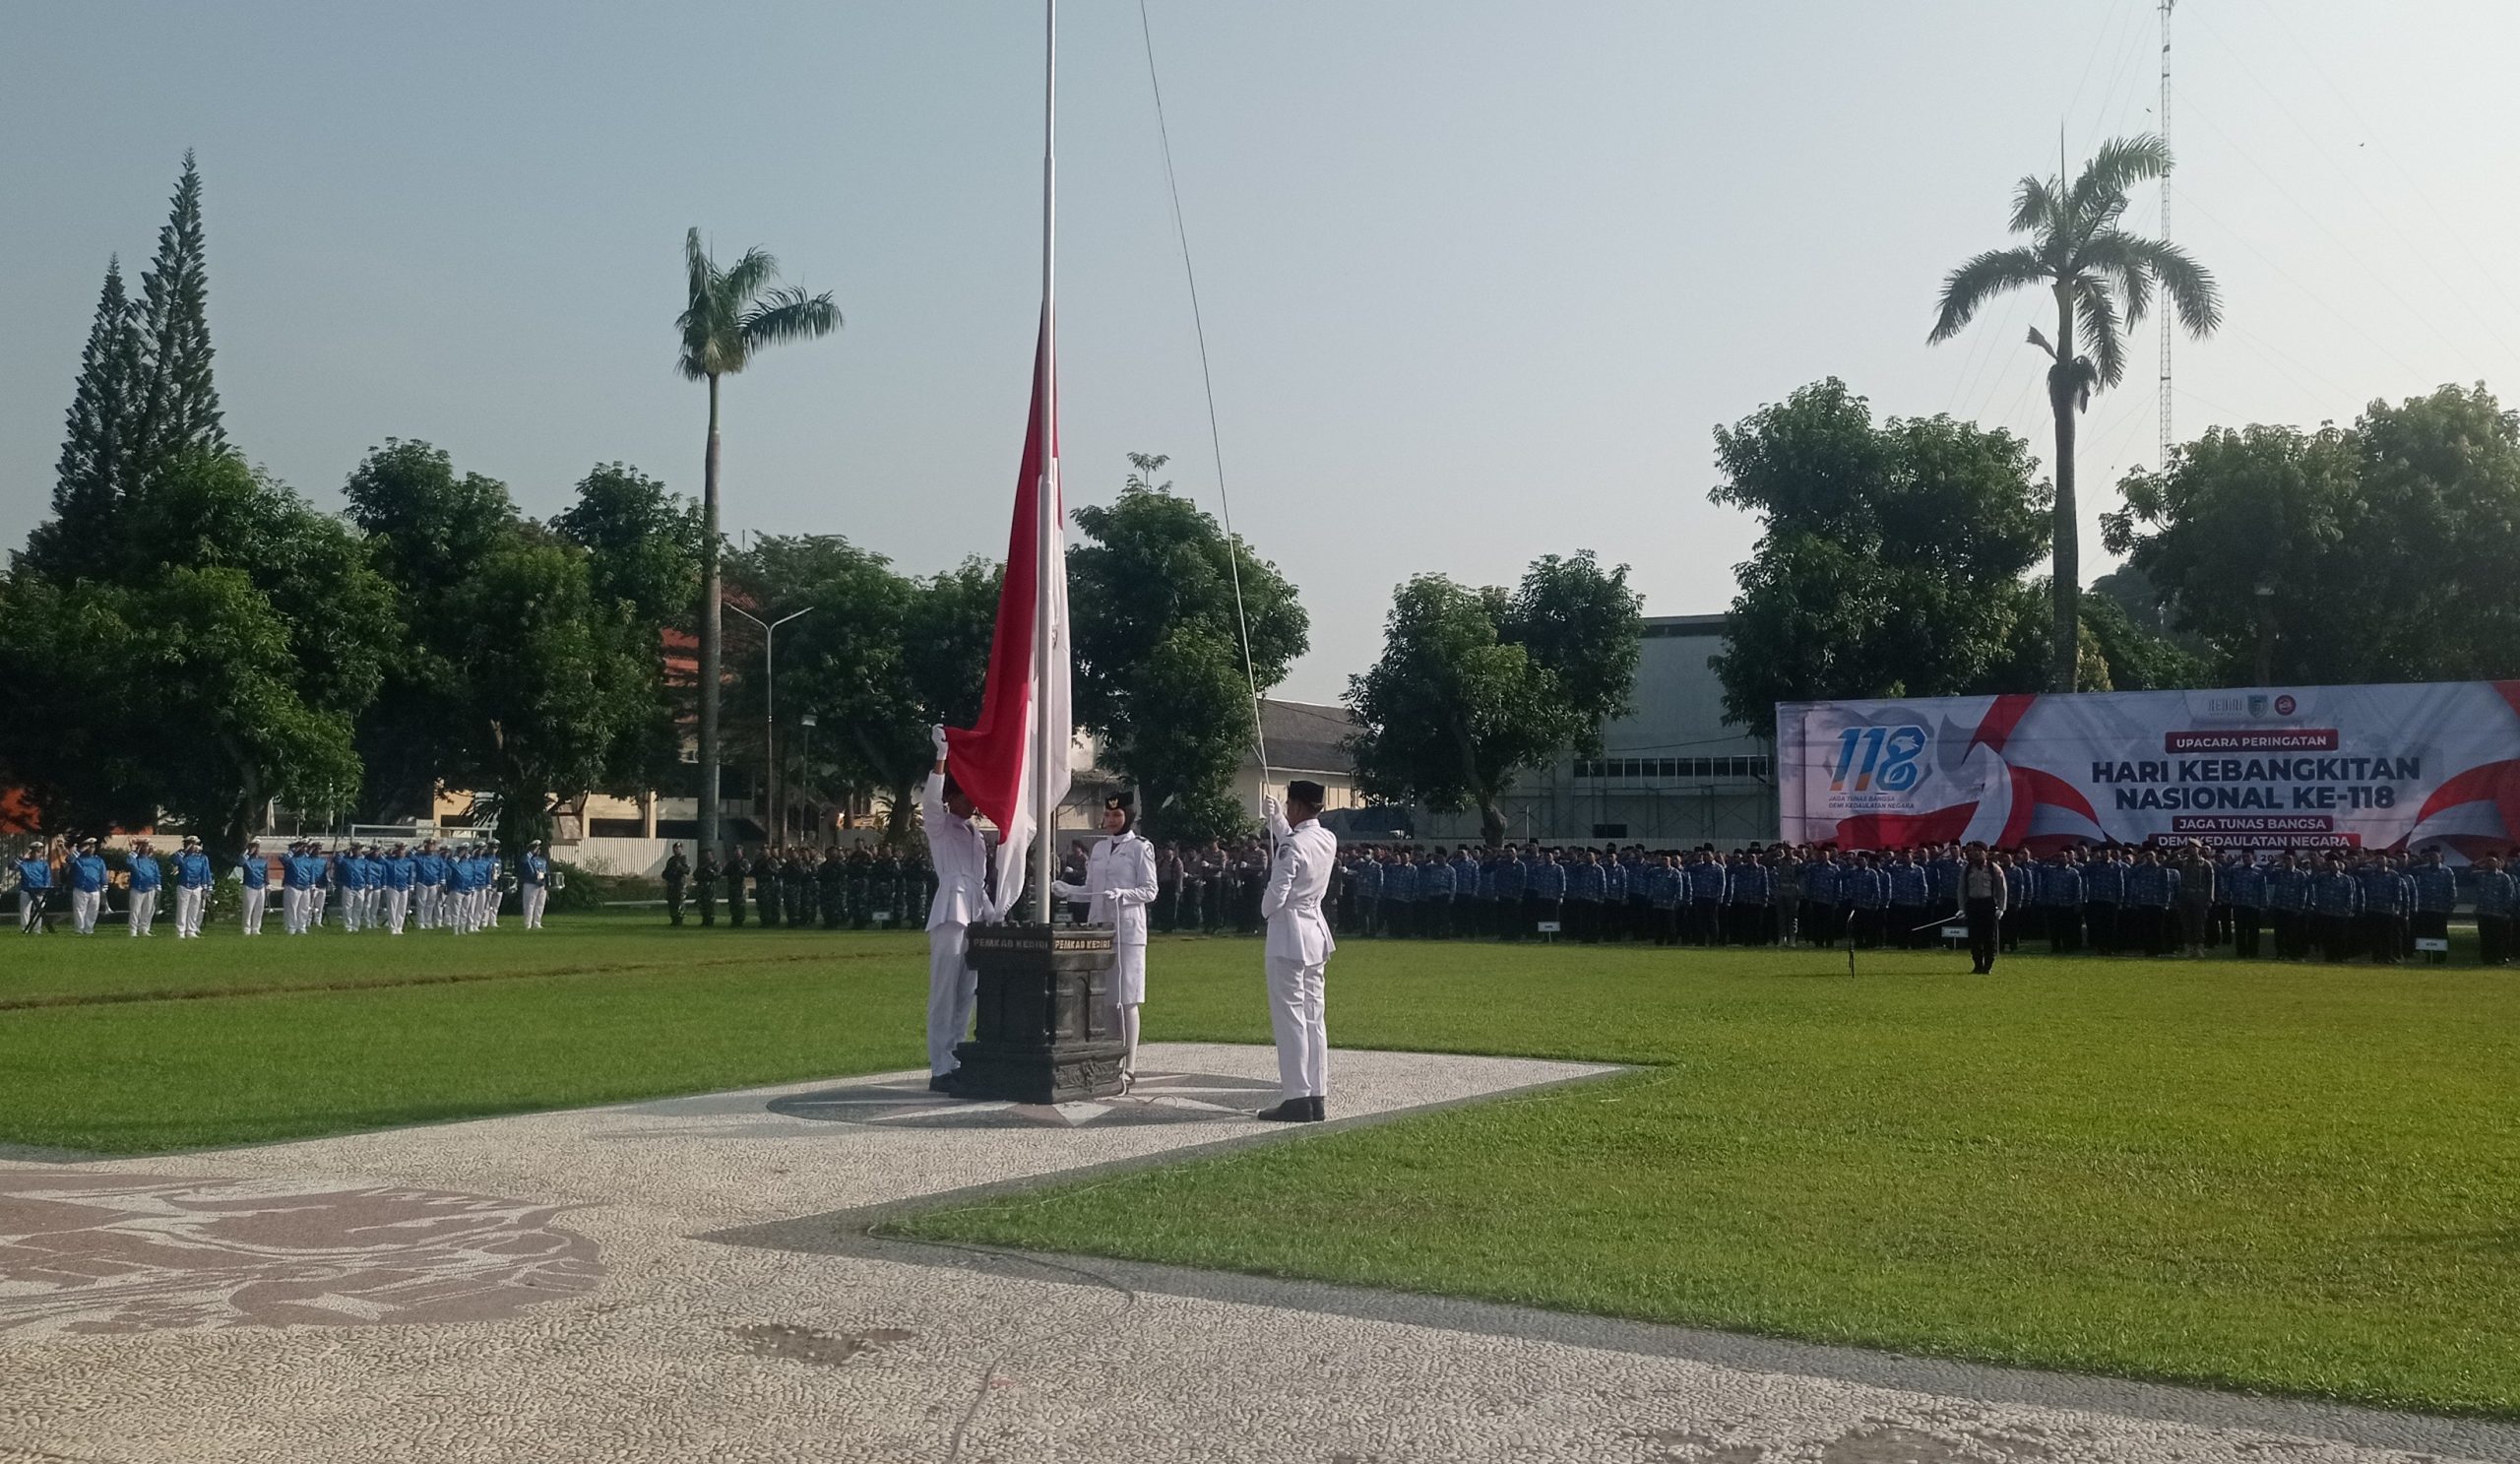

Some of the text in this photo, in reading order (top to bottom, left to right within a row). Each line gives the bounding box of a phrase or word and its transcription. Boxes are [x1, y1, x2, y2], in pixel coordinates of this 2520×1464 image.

[2175, 735, 2327, 748] UPACARA PERINGATAN
[1829, 726, 1926, 792] 118
[2092, 757, 2421, 783] HARI KEBANGKITAN
[2116, 785, 2396, 809] NASIONAL KE-118
[2178, 818, 2326, 829] JAGA TUNAS BANGSA
[2158, 836, 2190, 847] DEM
[2291, 836, 2351, 847] NEGARA
[974, 938, 1048, 950] PEMKAB KEDIRI
[1054, 939, 1110, 950] PEMKAB KEDIRI
